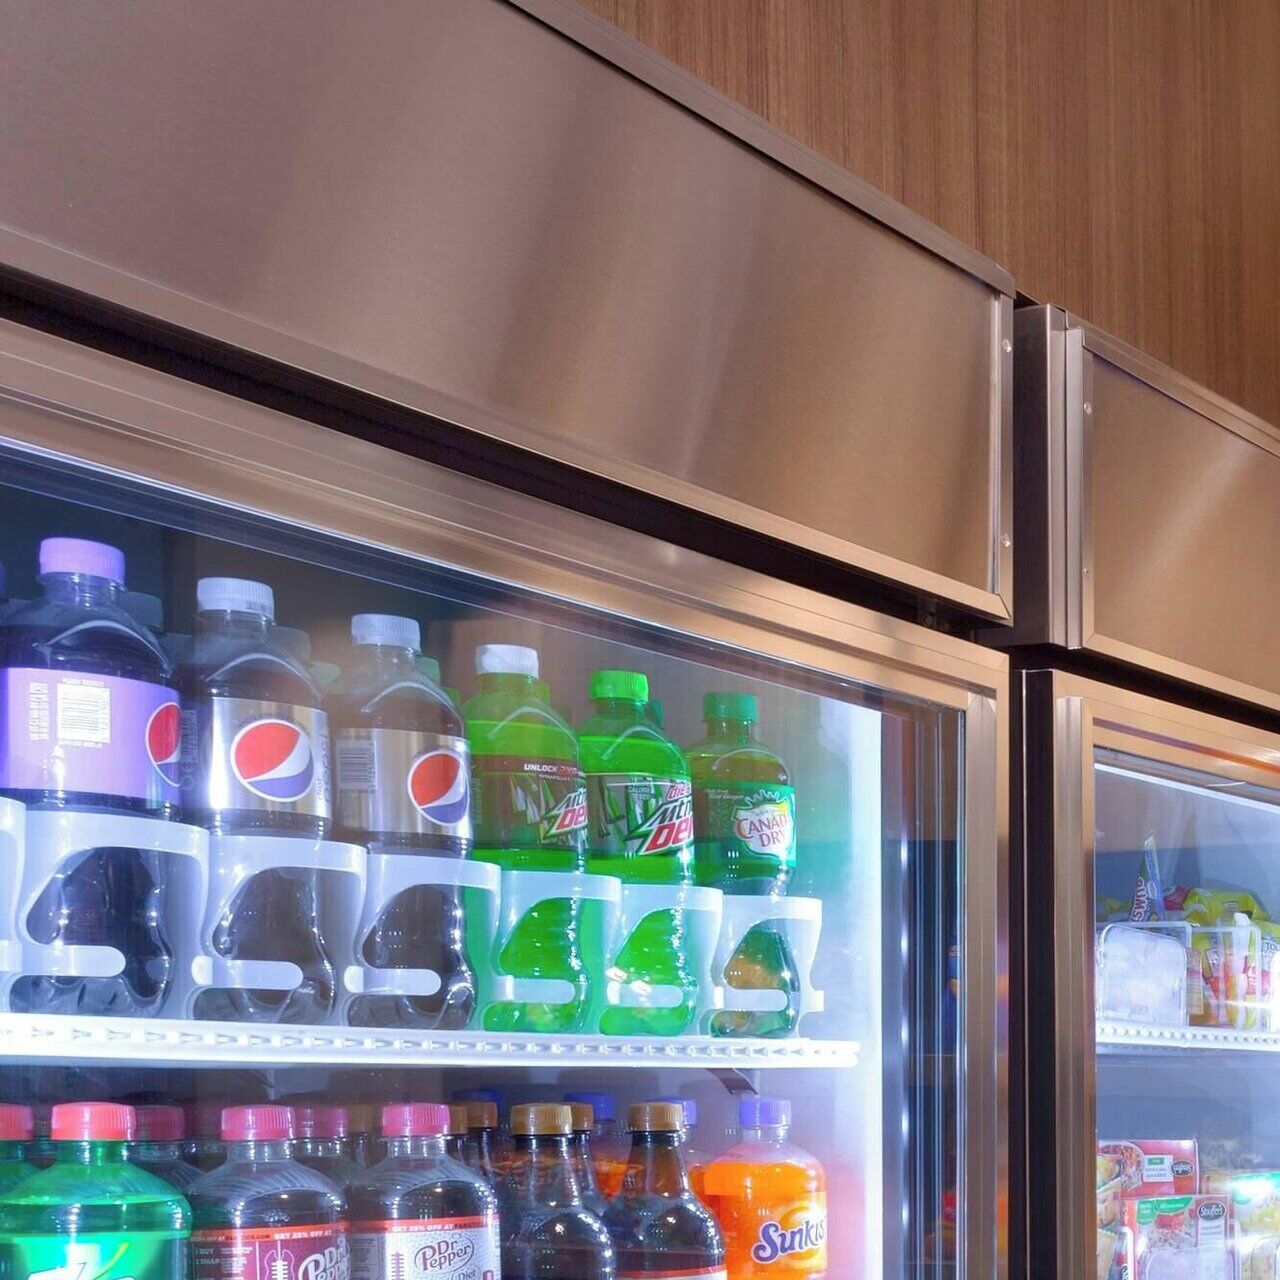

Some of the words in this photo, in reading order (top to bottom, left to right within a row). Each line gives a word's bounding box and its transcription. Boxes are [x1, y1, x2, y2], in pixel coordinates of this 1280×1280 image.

[524, 763, 558, 772] UNLOCK
[437, 1240, 458, 1253] Dr
[422, 1245, 471, 1271] Pepper
